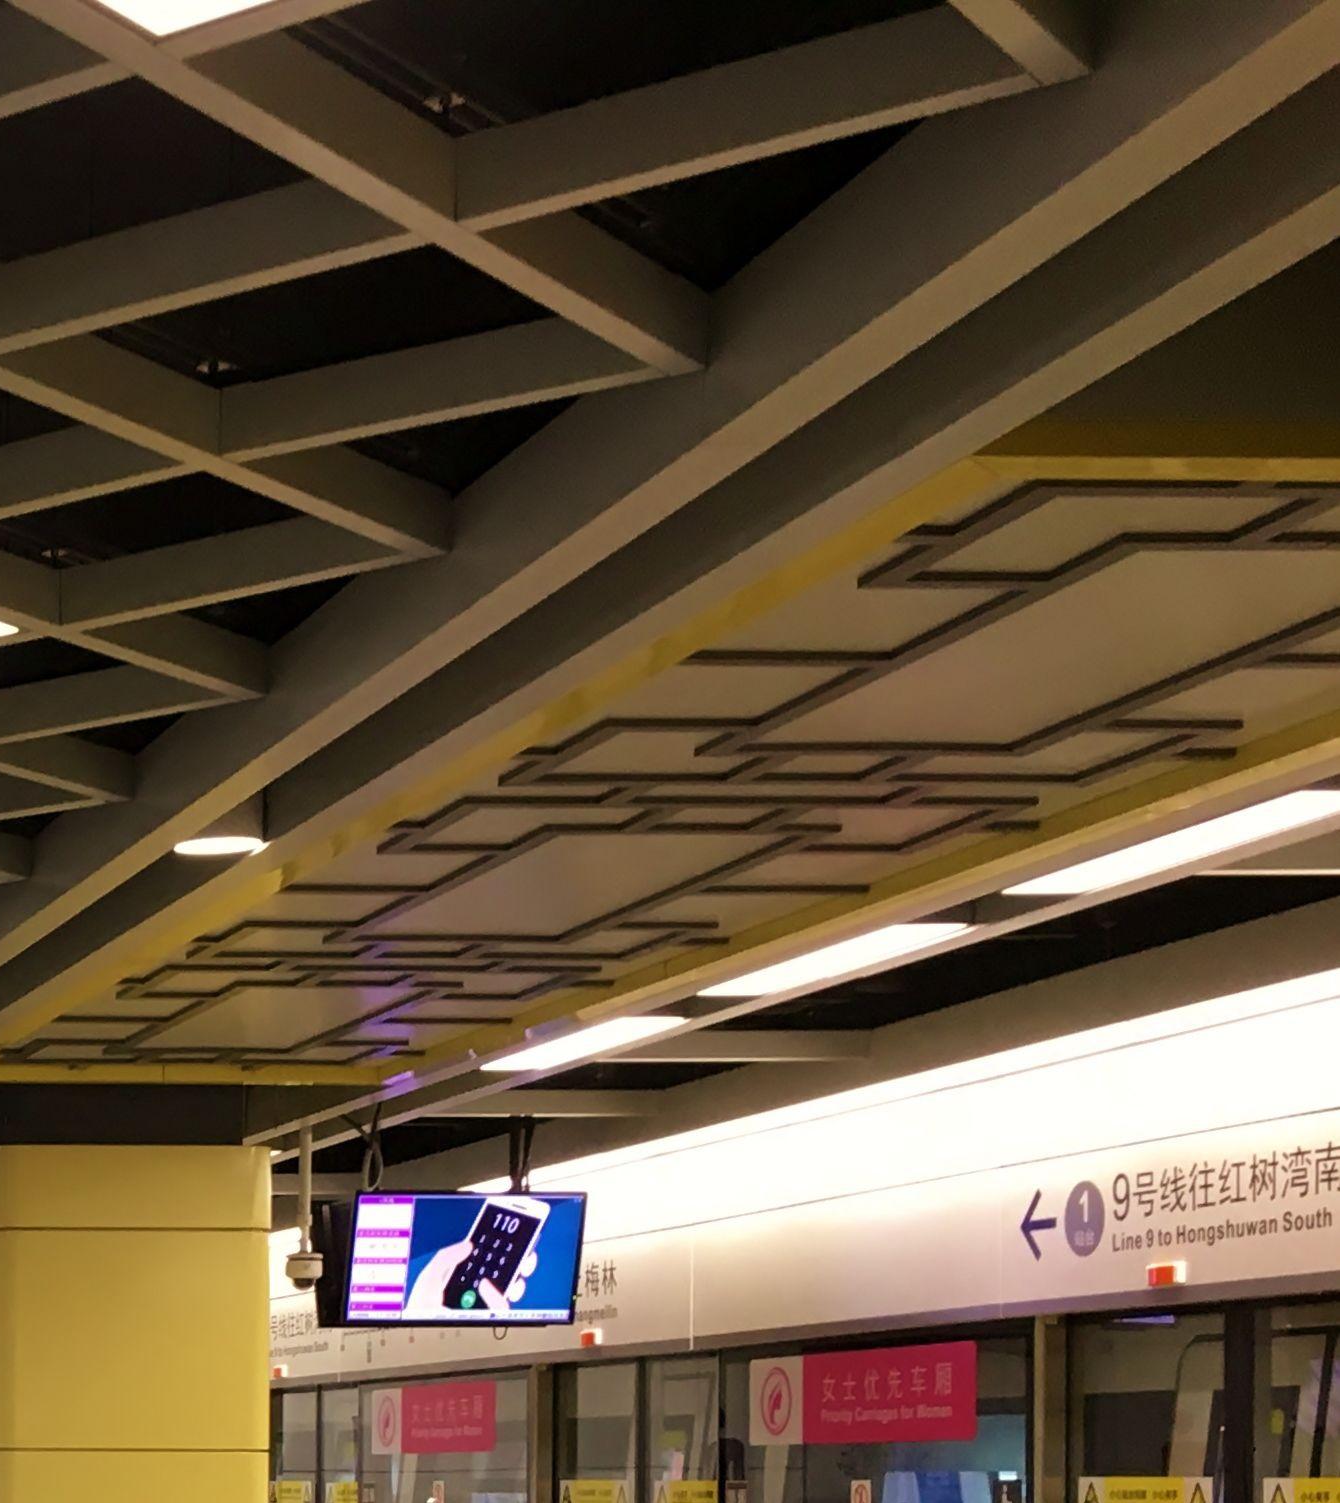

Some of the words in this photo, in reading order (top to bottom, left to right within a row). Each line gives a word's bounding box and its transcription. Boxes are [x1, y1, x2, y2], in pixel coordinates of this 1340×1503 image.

[1112, 1141, 1340, 1222] 9号线往红树湾南
[493, 1213, 520, 1234] 110
[1078, 1189, 1090, 1224] 1
[1112, 1232, 1142, 1252] Line
[1146, 1229, 1154, 1248] 9
[1157, 1228, 1171, 1246] to
[1176, 1218, 1278, 1246] Hongshuwan
[1283, 1207, 1333, 1231] South
[577, 1260, 617, 1298] 梅林
[822, 1361, 953, 1403] 女士优先车厢
